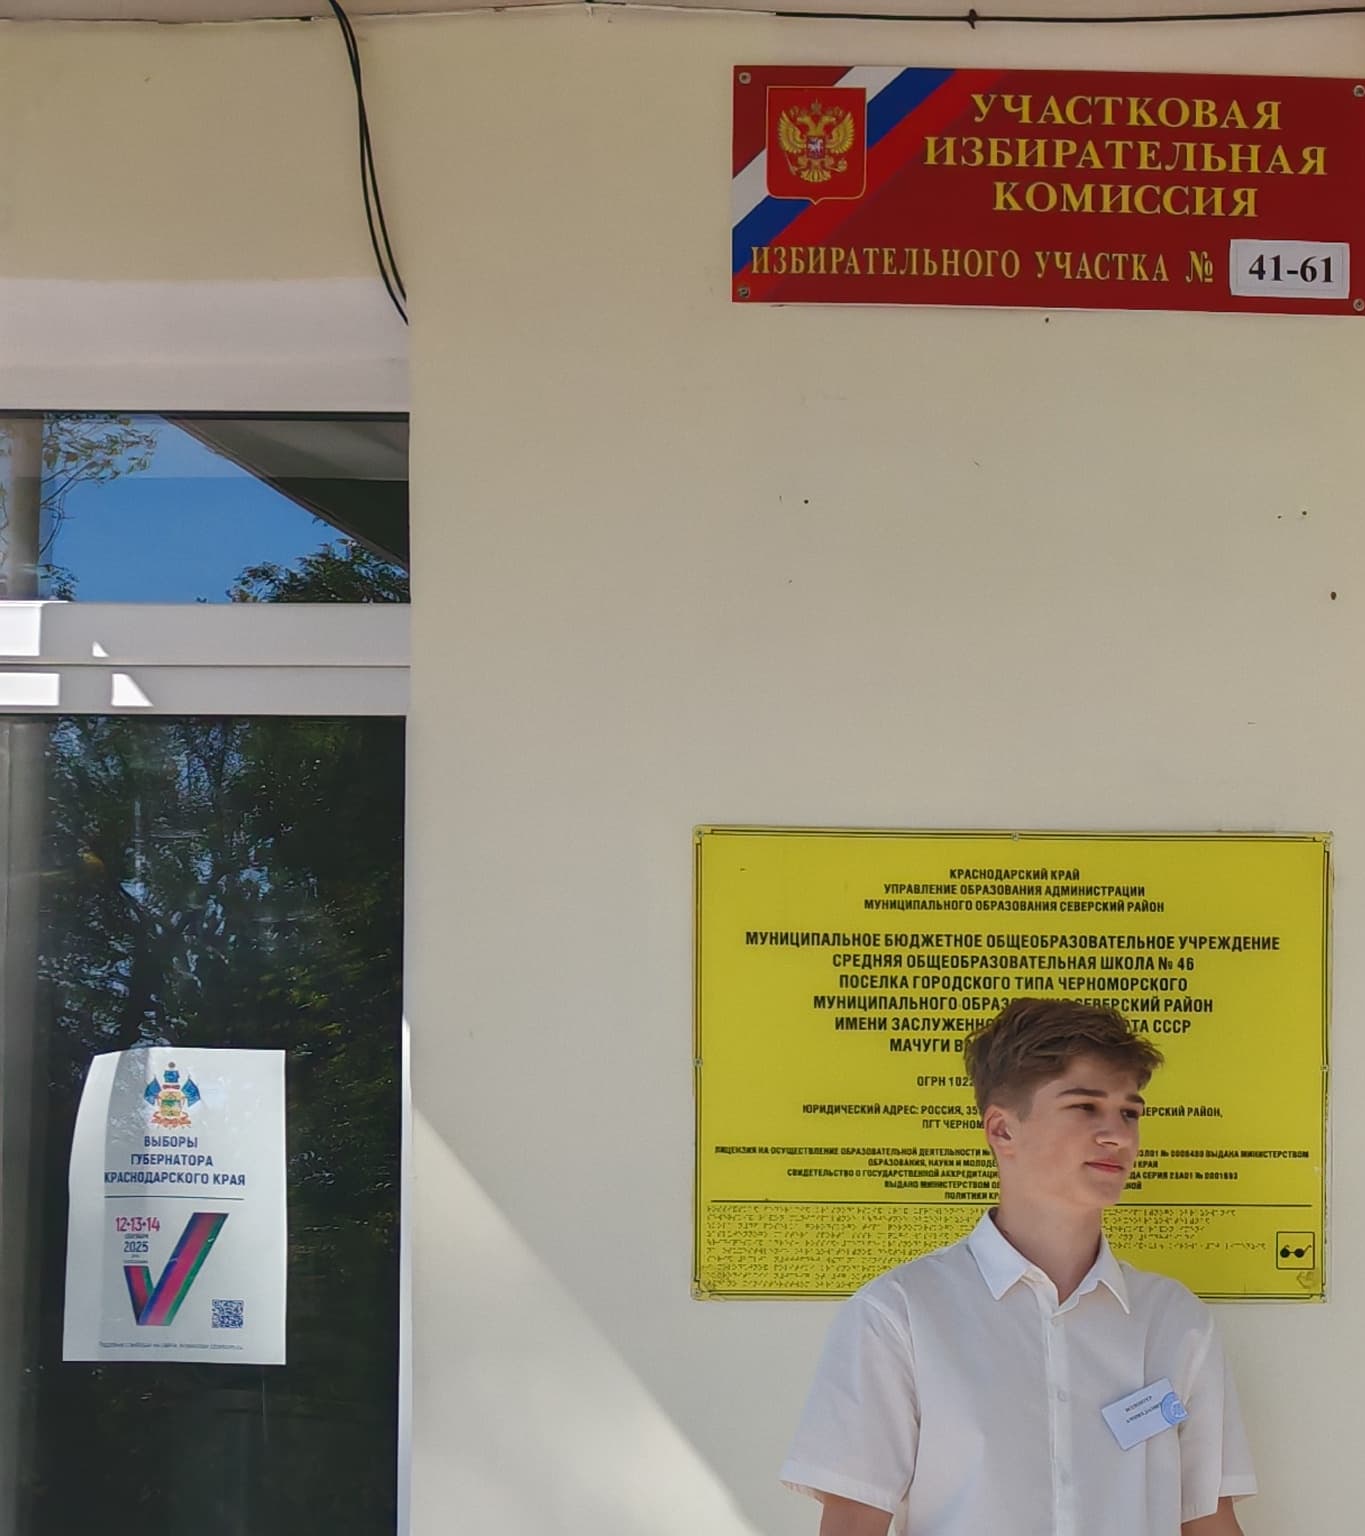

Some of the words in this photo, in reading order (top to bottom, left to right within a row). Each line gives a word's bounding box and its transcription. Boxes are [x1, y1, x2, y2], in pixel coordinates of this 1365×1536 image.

[970, 93, 1281, 131] УЧАСТКОВАЯ
[923, 136, 1327, 176] ИЗБИРАТЕЛЬНАЯ
[993, 181, 1258, 218] КОМИССИЯ
[751, 246, 1020, 278] ИЗБИРАТЕЛЬНОГО
[1035, 251, 1169, 282] УЧАСТКА
[1185, 250, 1214, 284] №
[1248, 253, 1334, 285] 41-61
[949, 868, 1048, 881] КРАСНОДАРСКИЙ
[1051, 868, 1080, 881] КРАЙ
[884, 883, 958, 896] УПРАВЛЕНИЕ
[960, 884, 1042, 896] ОБРАЗОВАНИЯ
[1044, 886, 1145, 898] АДМИНИСТРАЦИИ
[864, 899, 973, 911] МУНИЦИПАЛЬНОГО
[976, 900, 1058, 912] ОБРАЗОВАНИЯ
[1060, 899, 1124, 912] СЕВЕРСКИЙ
[1127, 900, 1165, 913] РАЙОН
[745, 931, 881, 948] МУНИЦИПАЛЬНОЕ
[884, 933, 982, 949] БЮДЖЕТНОЕ
[986, 934, 1175, 950] ОБЩЕОБРАЗОВАТЕЛЬНОЕ
[1179, 936, 1281, 952] УЧРЕЖДЕНИЕ
[832, 954, 902, 969] СРЕДНЯЯ
[907, 955, 1097, 970] ОБЩЕОБРАЗОВАТЕЛЬНАЯ
[1100, 956, 1154, 970] ШКОЛА
[1158, 957, 1173, 970] №
[1177, 957, 1195, 971] 46
[839, 974, 909, 989] ПОСЕЛКА
[912, 976, 1010, 991] ГОРОДСКОГО
[1015, 977, 1054, 990] ТИПА
[1058, 977, 1188, 991] ЧЕРНОМОРСКОГО
[813, 995, 957, 1011] МУНИЦИПАЛЬНОГО
[1164, 996, 1213, 1012] РАЙОН
[835, 1017, 887, 1031] ИМЕНИ
[891, 1017, 993, 1031] ЗАСЛУЖЕНН
[1153, 1019, 1191, 1033] СССР
[889, 1038, 950, 1052] МАЧУГИ
[917, 1076, 946, 1087] ОГРН
[803, 1103, 881, 1115] ЮРИДИЧЕСКИЙ
[882, 1105, 919, 1116] АДРЕС:
[921, 1105, 964, 1116] РОССИЯ,
[1143, 1105, 1185, 1117] ЕРСКИЙ
[1187, 1106, 1223, 1118] РАЙОН,
[922, 1119, 941, 1129] ПГТ
[144, 1136, 198, 1149] ВЫБОРЫ
[130, 1153, 214, 1167] ГУБЕРНАТОРА
[103, 1171, 209, 1185] КРАСНОДАРСКОГО
[213, 1173, 246, 1186] КРАЯ
[124, 1240, 149, 1253] 2025
